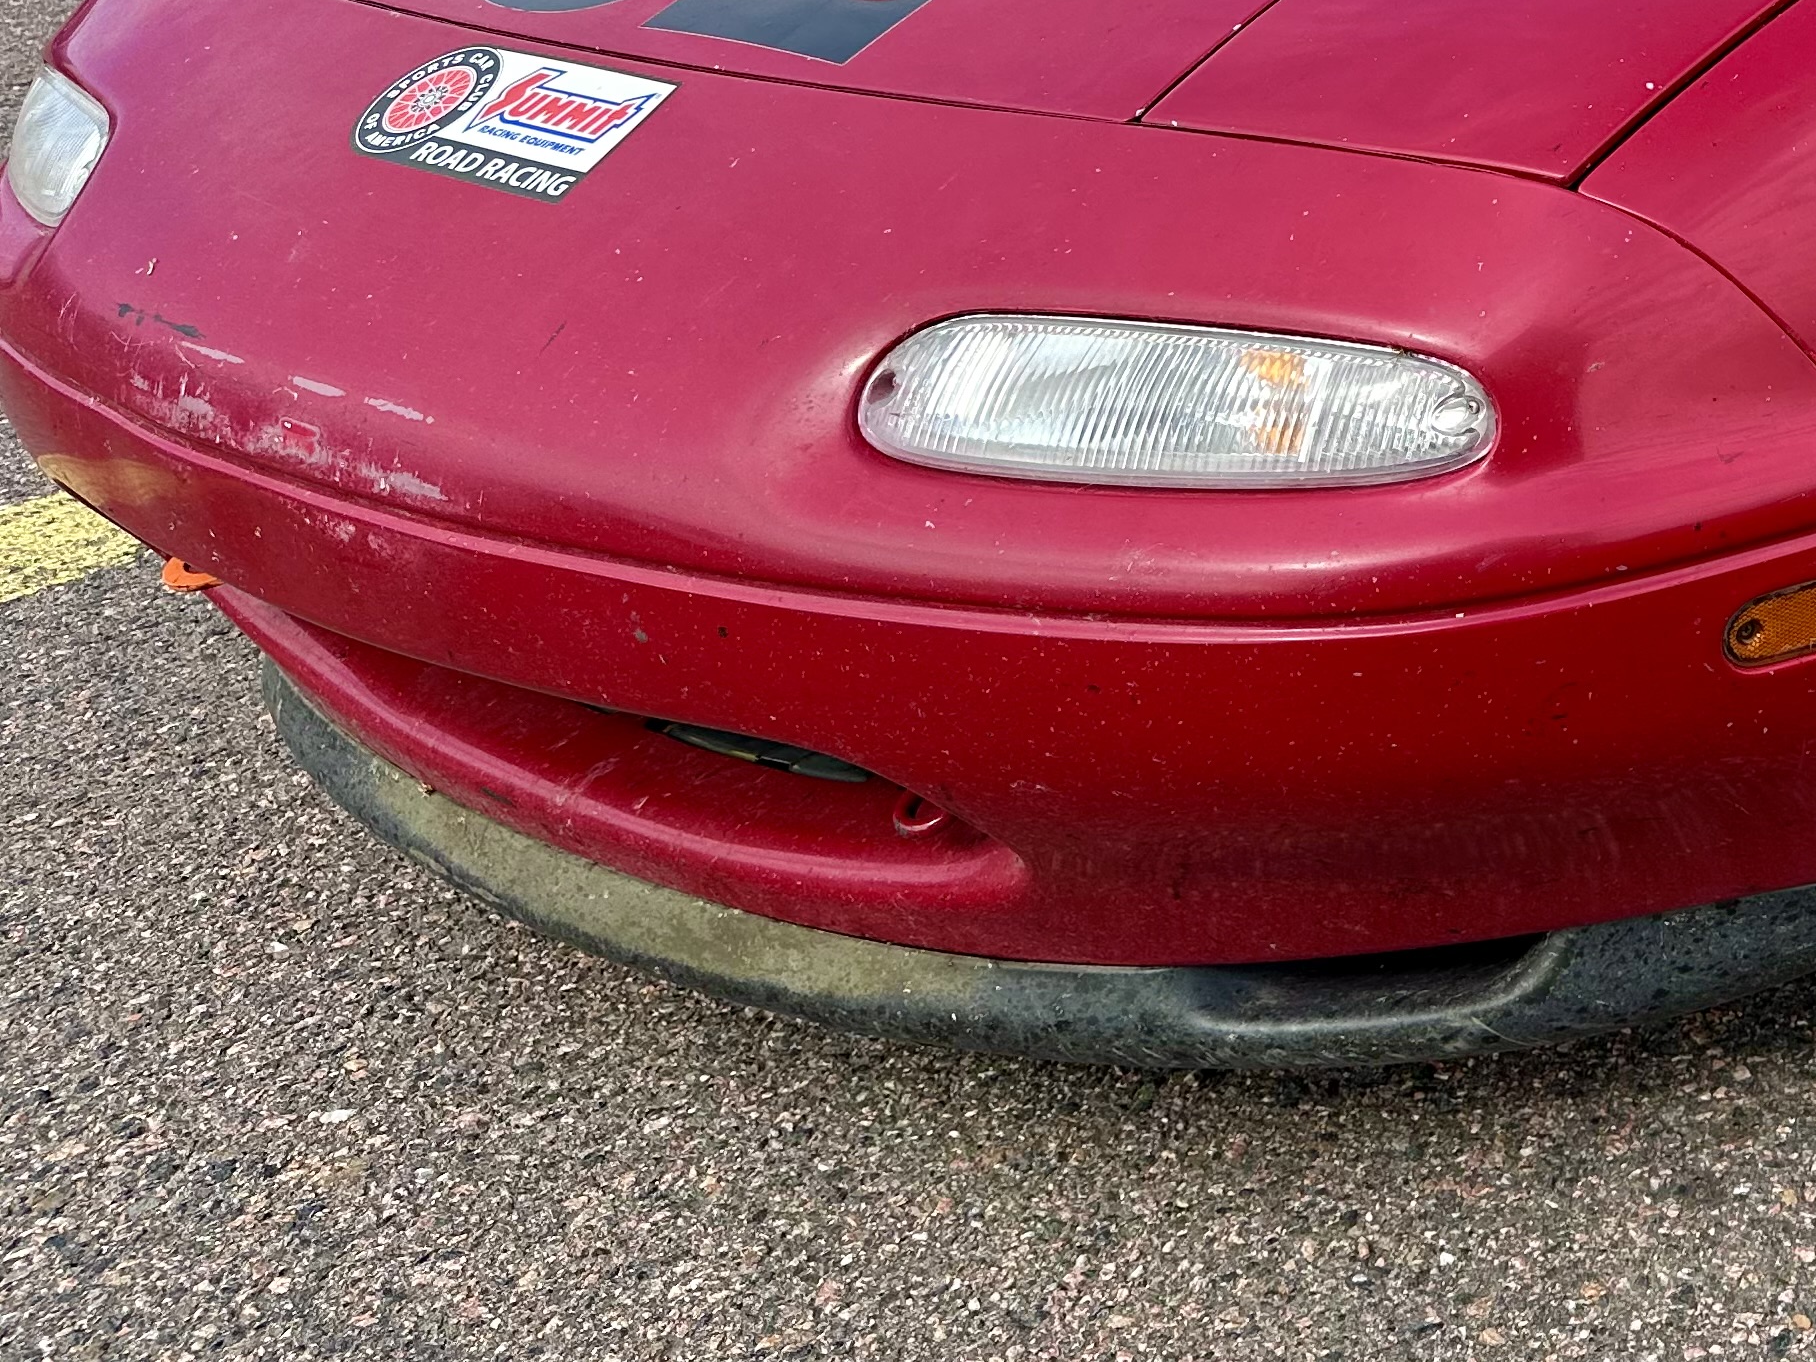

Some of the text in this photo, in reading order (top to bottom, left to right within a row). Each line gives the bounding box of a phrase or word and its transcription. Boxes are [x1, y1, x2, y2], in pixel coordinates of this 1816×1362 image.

[386, 52, 496, 112] SPORTS CAR CLUB
[363, 112, 441, 147] OF AMERICA
[478, 124, 586, 157] RACING EQUIPMENT
[408, 141, 577, 197] ROAD RACING
